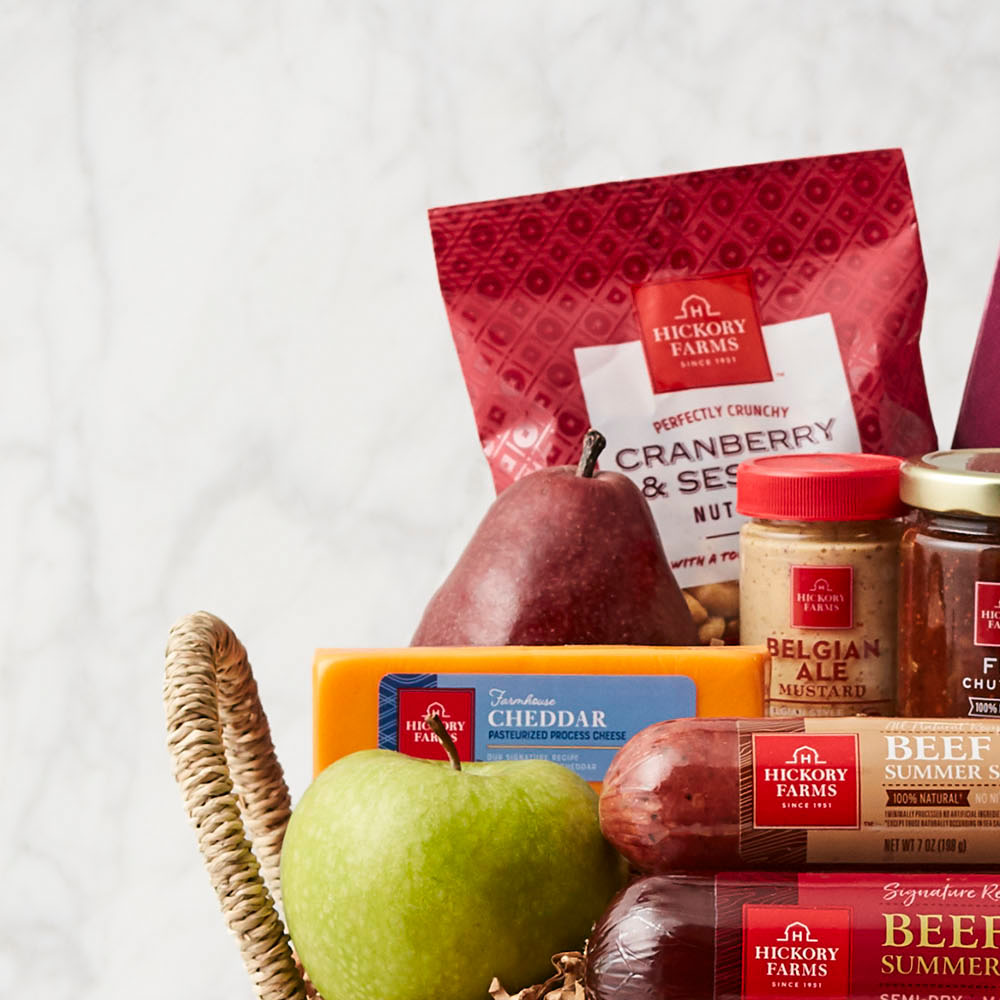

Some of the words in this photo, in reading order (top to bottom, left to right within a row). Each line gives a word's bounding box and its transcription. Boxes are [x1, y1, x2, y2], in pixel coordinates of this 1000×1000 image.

[652, 318, 747, 343] HICKORY
[670, 337, 739, 357] FARMS
[681, 359, 712, 368] SINCE
[653, 406, 723, 435] PERFECTLY
[727, 404, 790, 418] CRUNCHY
[615, 418, 837, 471] CRANBERRY
[642, 476, 667, 499] &
[694, 502, 733, 523] NUT
[671, 555, 705, 570] WITH
[708, 553, 717, 565] A
[796, 593, 845, 603] HICKORY
[803, 603, 840, 612] FARMS
[767, 637, 881, 660] BELGIAN
[796, 662, 849, 681] ALE
[488, 688, 556, 707] Farmhouse
[779, 683, 867, 698] MUSTARD
[975, 702, 998, 713] 100%
[488, 709, 607, 728] CHEDDAR
[488, 730, 548, 740] PASTEURIZED
[550, 730, 592, 740] PROCESS
[593, 730, 627, 740] CHEESE
[884, 736, 992, 761] BEEF
[764, 768, 848, 782] HICKORY
[884, 764, 981, 780] SUMMER
[776, 784, 838, 797] FARMS
[893, 792, 917, 804] 100%
[975, 793, 988, 804] NO
[884, 838, 900, 852] NET
[901, 838, 917, 852] WT
[918, 838, 923, 852] 7
[925, 838, 936, 852] OZ
[883, 881, 977, 907] Signature
[755, 946, 839, 961] HICKORY
[766, 962, 828, 977] FARMS
